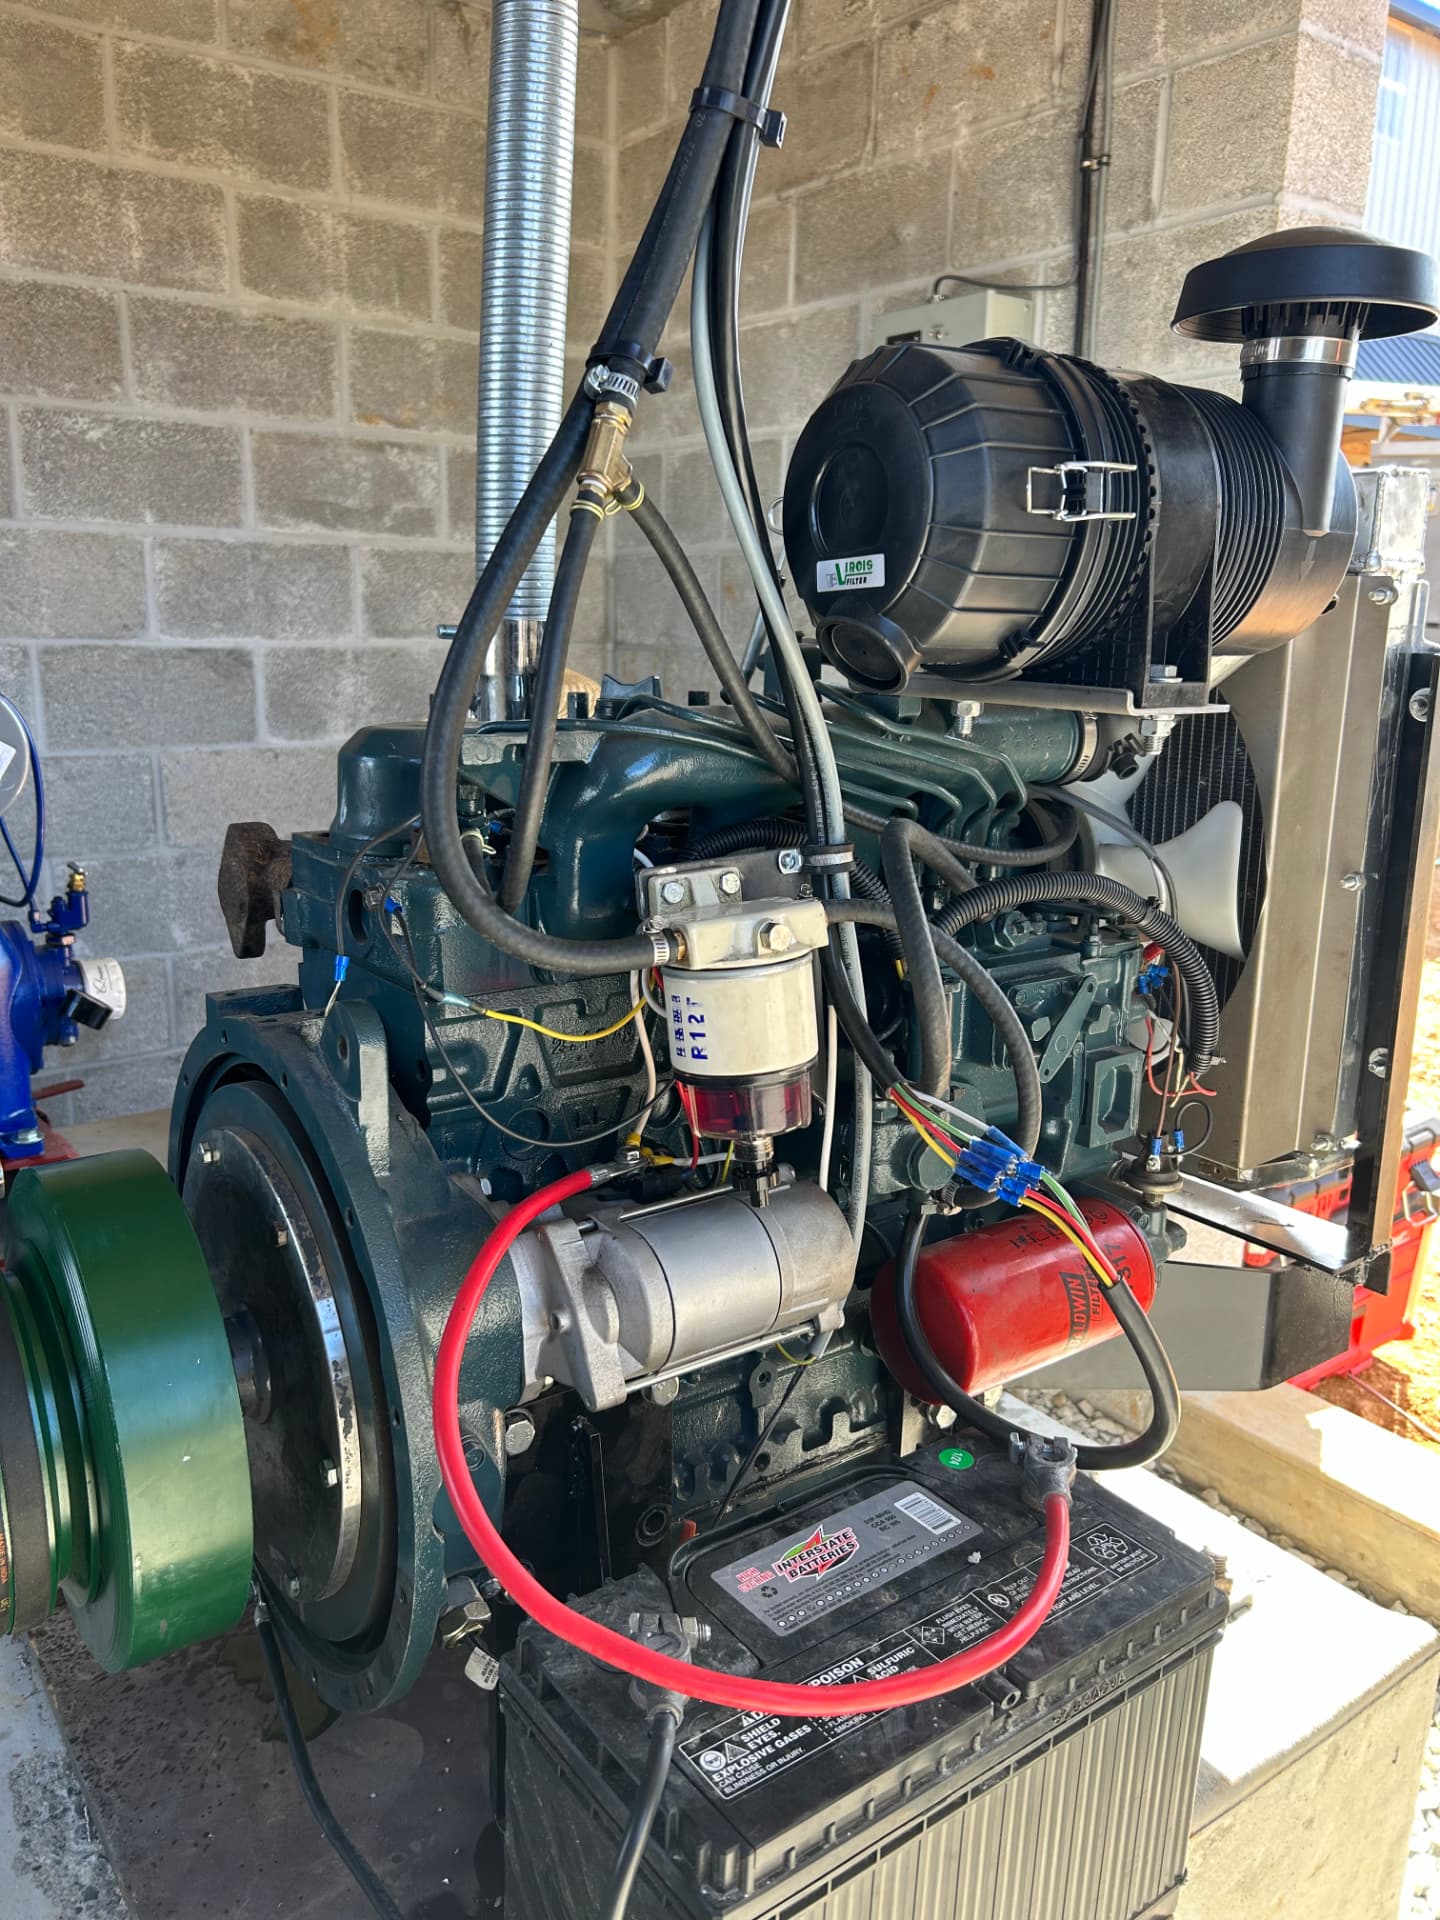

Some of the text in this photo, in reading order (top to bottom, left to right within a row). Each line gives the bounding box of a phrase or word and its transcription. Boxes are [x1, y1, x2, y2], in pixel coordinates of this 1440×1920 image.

[846, 576, 867, 585] FILTER
[777, 1531, 852, 1572] INTERSTATE
[788, 1541, 856, 1578] BATTERIES
[866, 1646, 915, 1675] SULFURIC
[874, 1665, 899, 1681] ACID
[740, 1718, 781, 1743] SHIELD
[834, 1714, 867, 1733] SMOKING
[712, 1725, 812, 1781] EXPLOSIVE GASES
[719, 1763, 762, 1788] CAN CAUSE
[722, 1769, 766, 1794] BLINDNESS
[766, 1761, 779, 1771] OR
